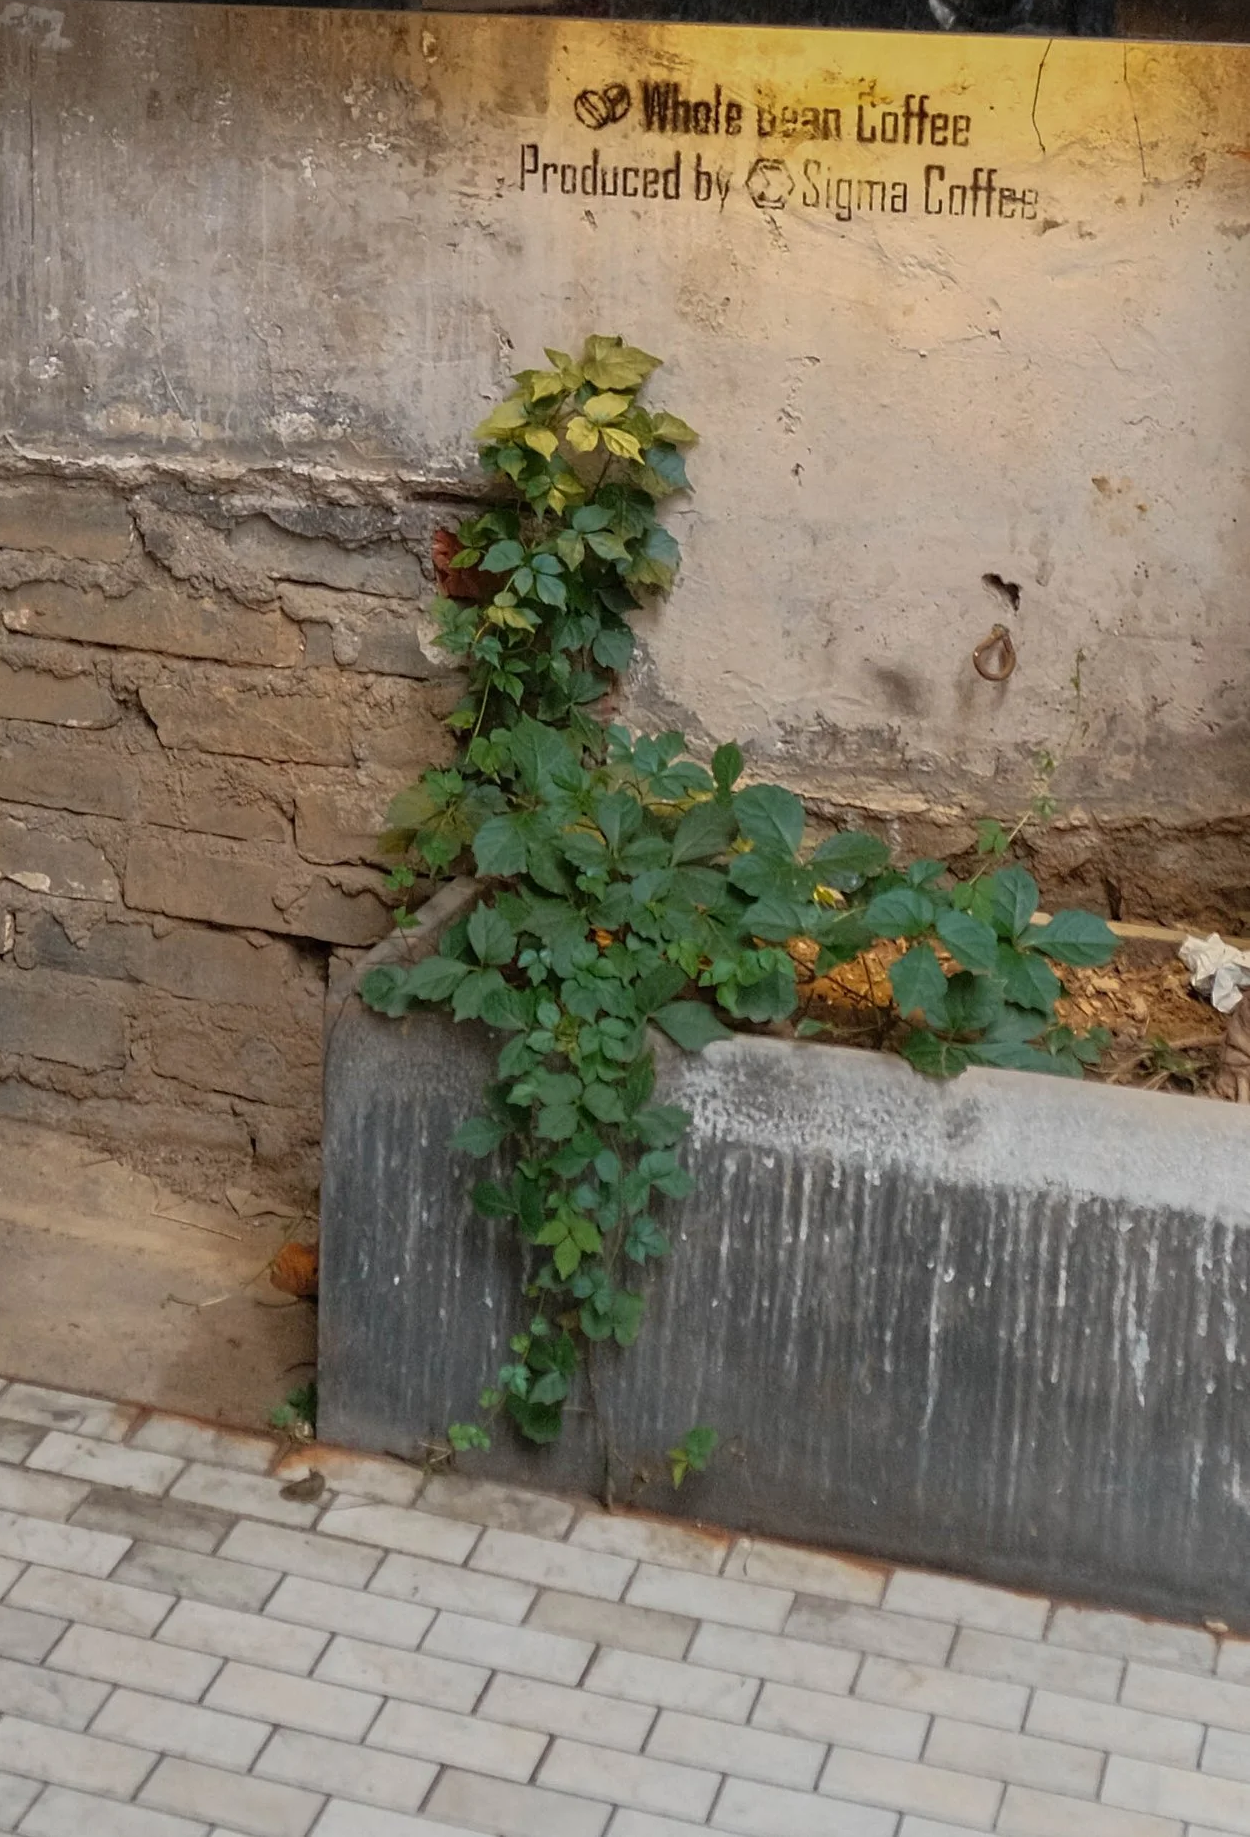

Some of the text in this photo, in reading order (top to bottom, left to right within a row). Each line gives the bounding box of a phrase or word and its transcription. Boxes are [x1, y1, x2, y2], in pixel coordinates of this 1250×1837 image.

[639, 79, 743, 135] Whole
[855, 91, 972, 147] Coffee
[519, 143, 1039, 222] Produced by Sigma Coffee
